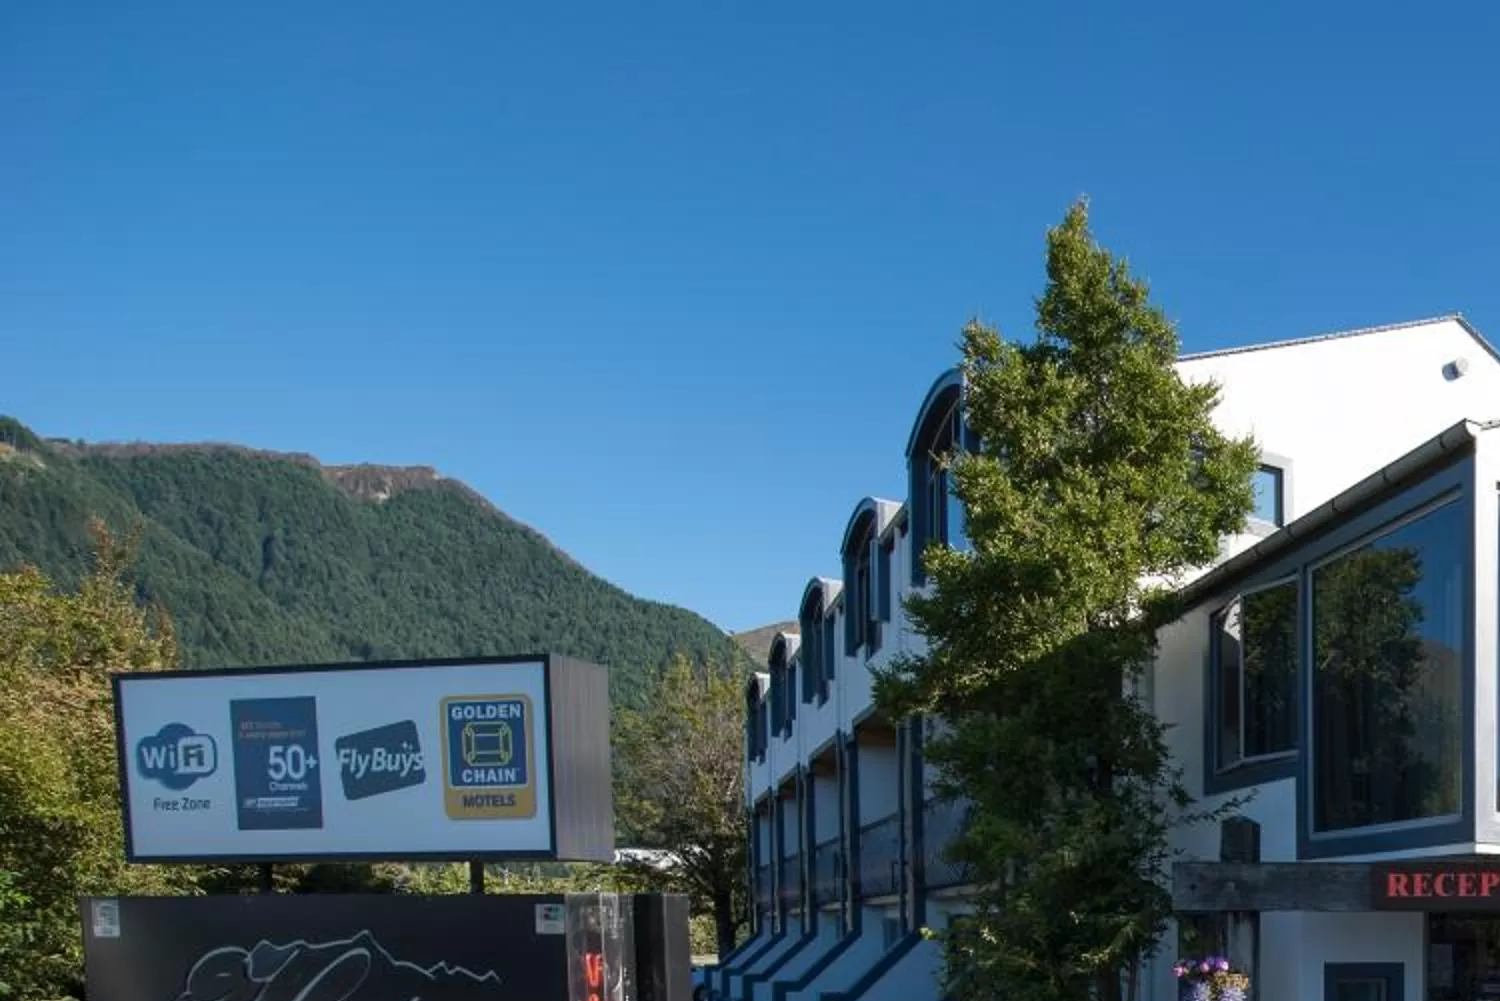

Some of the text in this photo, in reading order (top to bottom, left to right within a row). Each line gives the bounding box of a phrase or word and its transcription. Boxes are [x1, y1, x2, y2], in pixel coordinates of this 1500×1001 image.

[451, 703, 522, 720] GOLDEN
[267, 743, 319, 781] 50+
[339, 746, 425, 780] FlyBuys
[461, 768, 517, 784] CHAIN
[153, 796, 212, 812] Free Zone
[462, 793, 517, 808] MOTELS
